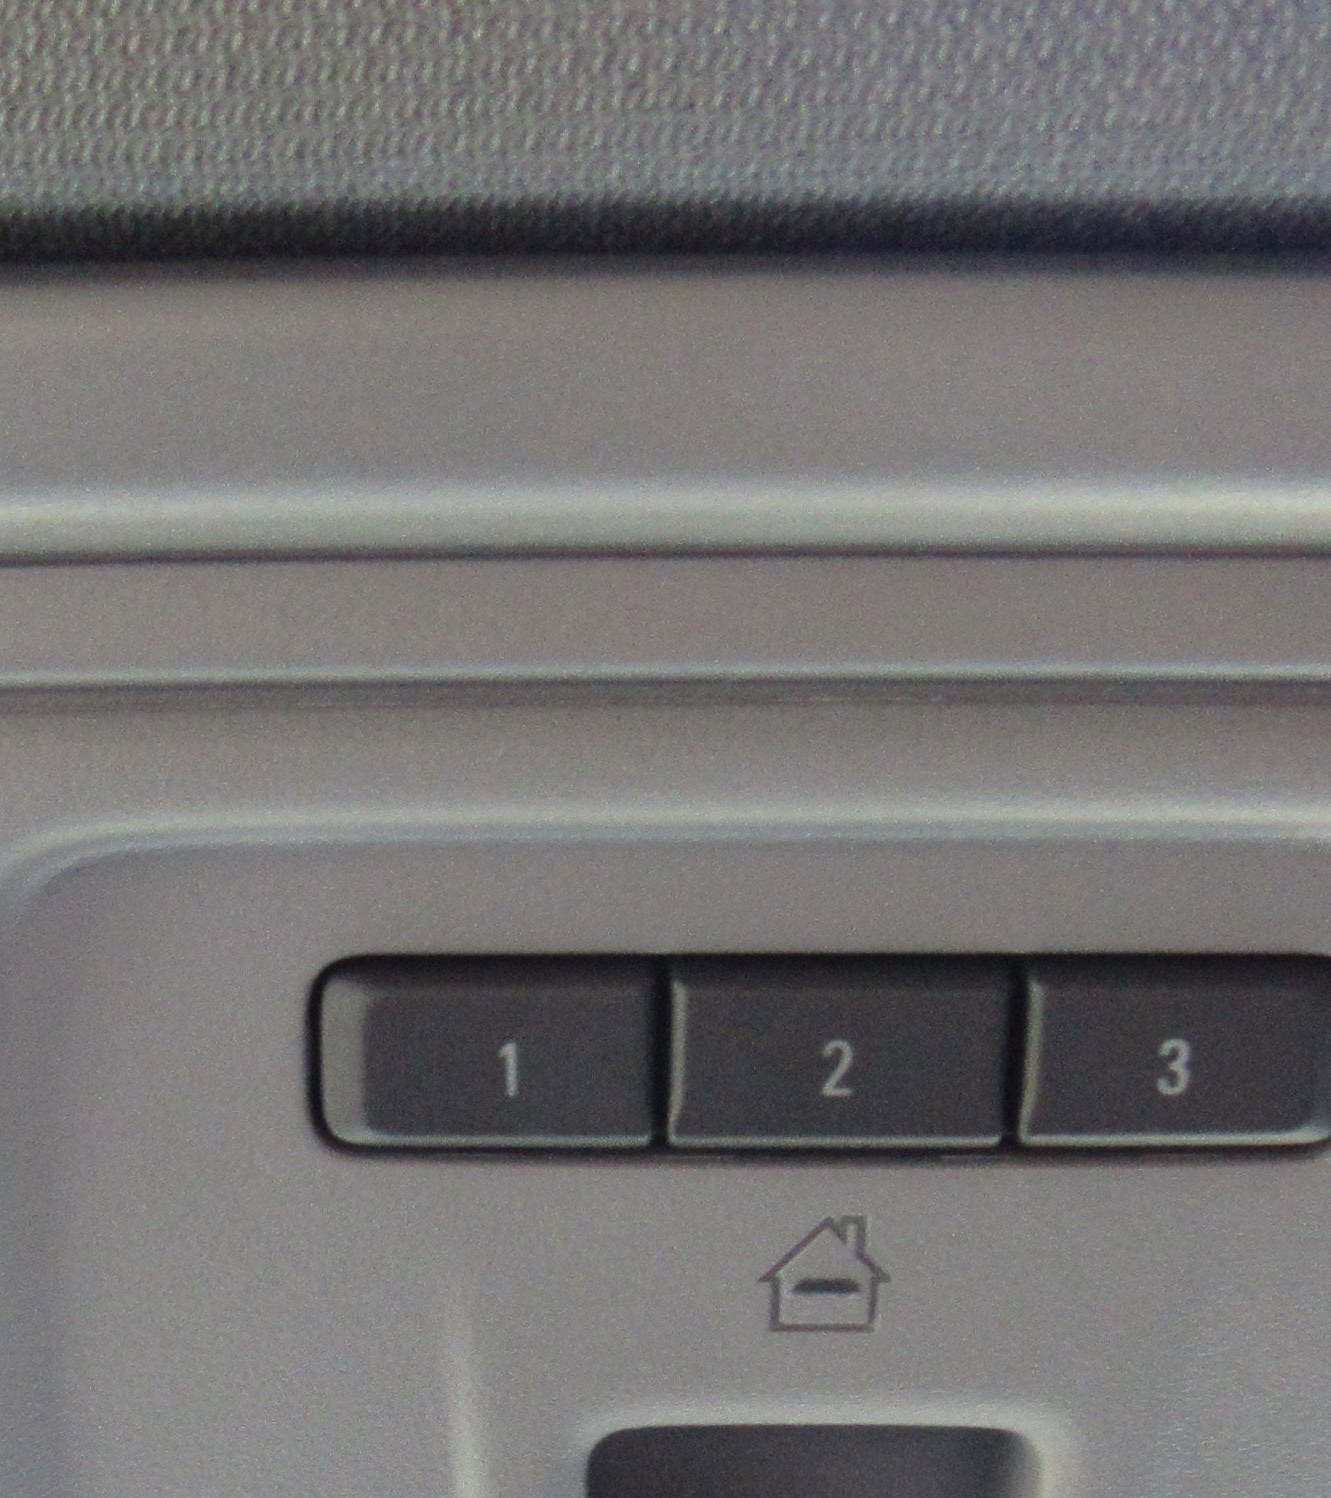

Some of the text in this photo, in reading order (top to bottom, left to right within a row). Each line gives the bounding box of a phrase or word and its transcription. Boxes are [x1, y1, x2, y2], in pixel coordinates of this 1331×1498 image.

[497, 1041, 520, 1099] 1
[820, 1039, 855, 1099] 2
[1155, 1038, 1193, 1096] 3
